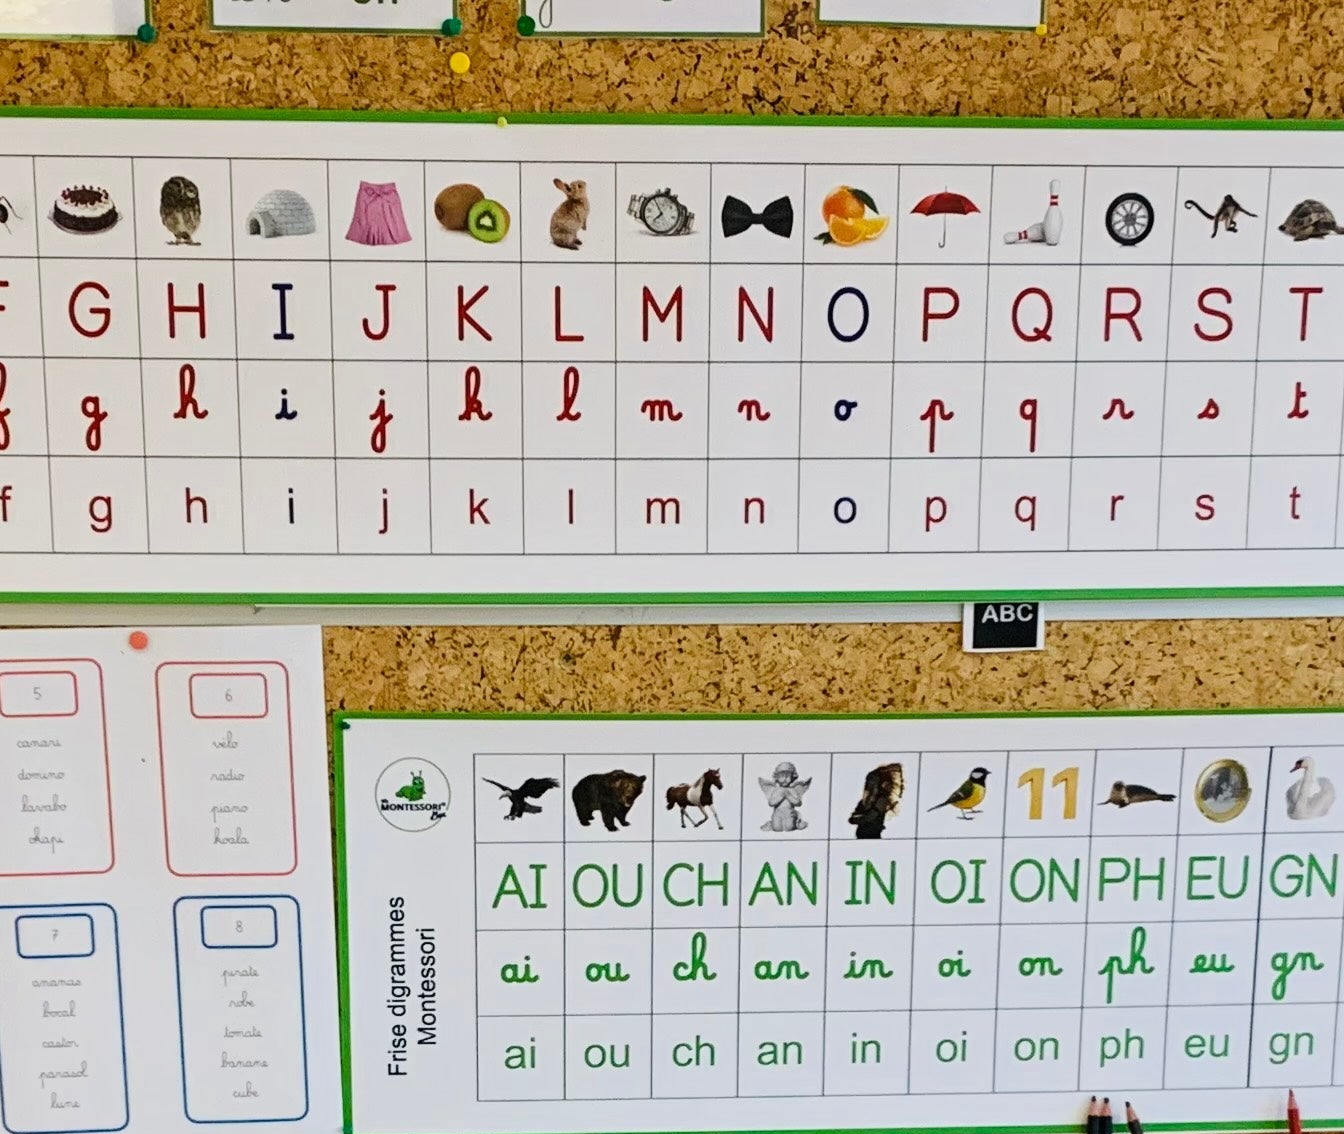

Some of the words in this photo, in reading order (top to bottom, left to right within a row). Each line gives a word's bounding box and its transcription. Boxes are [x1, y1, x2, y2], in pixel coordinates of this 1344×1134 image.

[67, 280, 112, 339] G
[166, 281, 207, 340] H
[271, 282, 296, 341] I
[361, 283, 398, 342] J
[457, 284, 493, 342] K
[554, 285, 585, 343] L
[641, 284, 684, 343] M
[737, 285, 775, 344] N
[826, 286, 870, 343] O
[921, 286, 961, 343] P
[1011, 286, 1054, 343] Q
[1103, 286, 1144, 343] R
[1193, 286, 1234, 343] S
[1288, 286, 1324, 342] T
[981, 603, 1034, 624] ABC
[33, 686, 43, 701] 5
[224, 688, 233, 703] 6
[15, 739, 62, 749] canari
[17, 768, 65, 781] domino
[210, 768, 246, 782] radio
[20, 793, 68, 813] lavabo
[1017, 766, 1080, 821] 11
[210, 803, 249, 823] piano
[381, 802, 442, 812] MONTESSORI
[28, 825, 65, 854] okapi
[212, 826, 250, 846] koala
[491, 863, 548, 910] AI
[571, 862, 644, 909] OU
[662, 861, 729, 908] CH
[747, 859, 819, 907] AN
[843, 859, 897, 906] IN
[930, 858, 987, 905] OI
[1009, 857, 1081, 904] ON
[1097, 856, 1166, 902] PH
[1186, 854, 1250, 901] EU
[1268, 852, 1339, 899] GN
[234, 920, 244, 934] 8
[386, 896, 411, 1017] digrammes
[499, 954, 540, 984] ai
[584, 961, 631, 983] ou
[672, 931, 718, 982] ch
[753, 959, 810, 981] an
[842, 950, 895, 980] in
[937, 949, 972, 978] oi
[1017, 956, 1064, 977] on
[1097, 925, 1156, 1005] ph
[1188, 953, 1236, 974] eu
[1270, 951, 1325, 1002] gn
[415, 927, 437, 1046] Montessori
[223, 1025, 263, 1039] tomate
[387, 1024, 408, 1076] Frise
[504, 1036, 536, 1070] ai
[583, 1043, 631, 1069] ou
[671, 1034, 716, 1068] ch
[756, 1040, 803, 1066] an
[851, 1031, 882, 1064] in
[935, 1030, 968, 1064] oi
[1013, 1036, 1060, 1062] on
[1099, 1027, 1145, 1069] ph
[1184, 1033, 1230, 1059] eu
[1268, 1031, 1315, 1065] gn
[220, 1050, 269, 1069] banane
[38, 1060, 89, 1089] parasol
